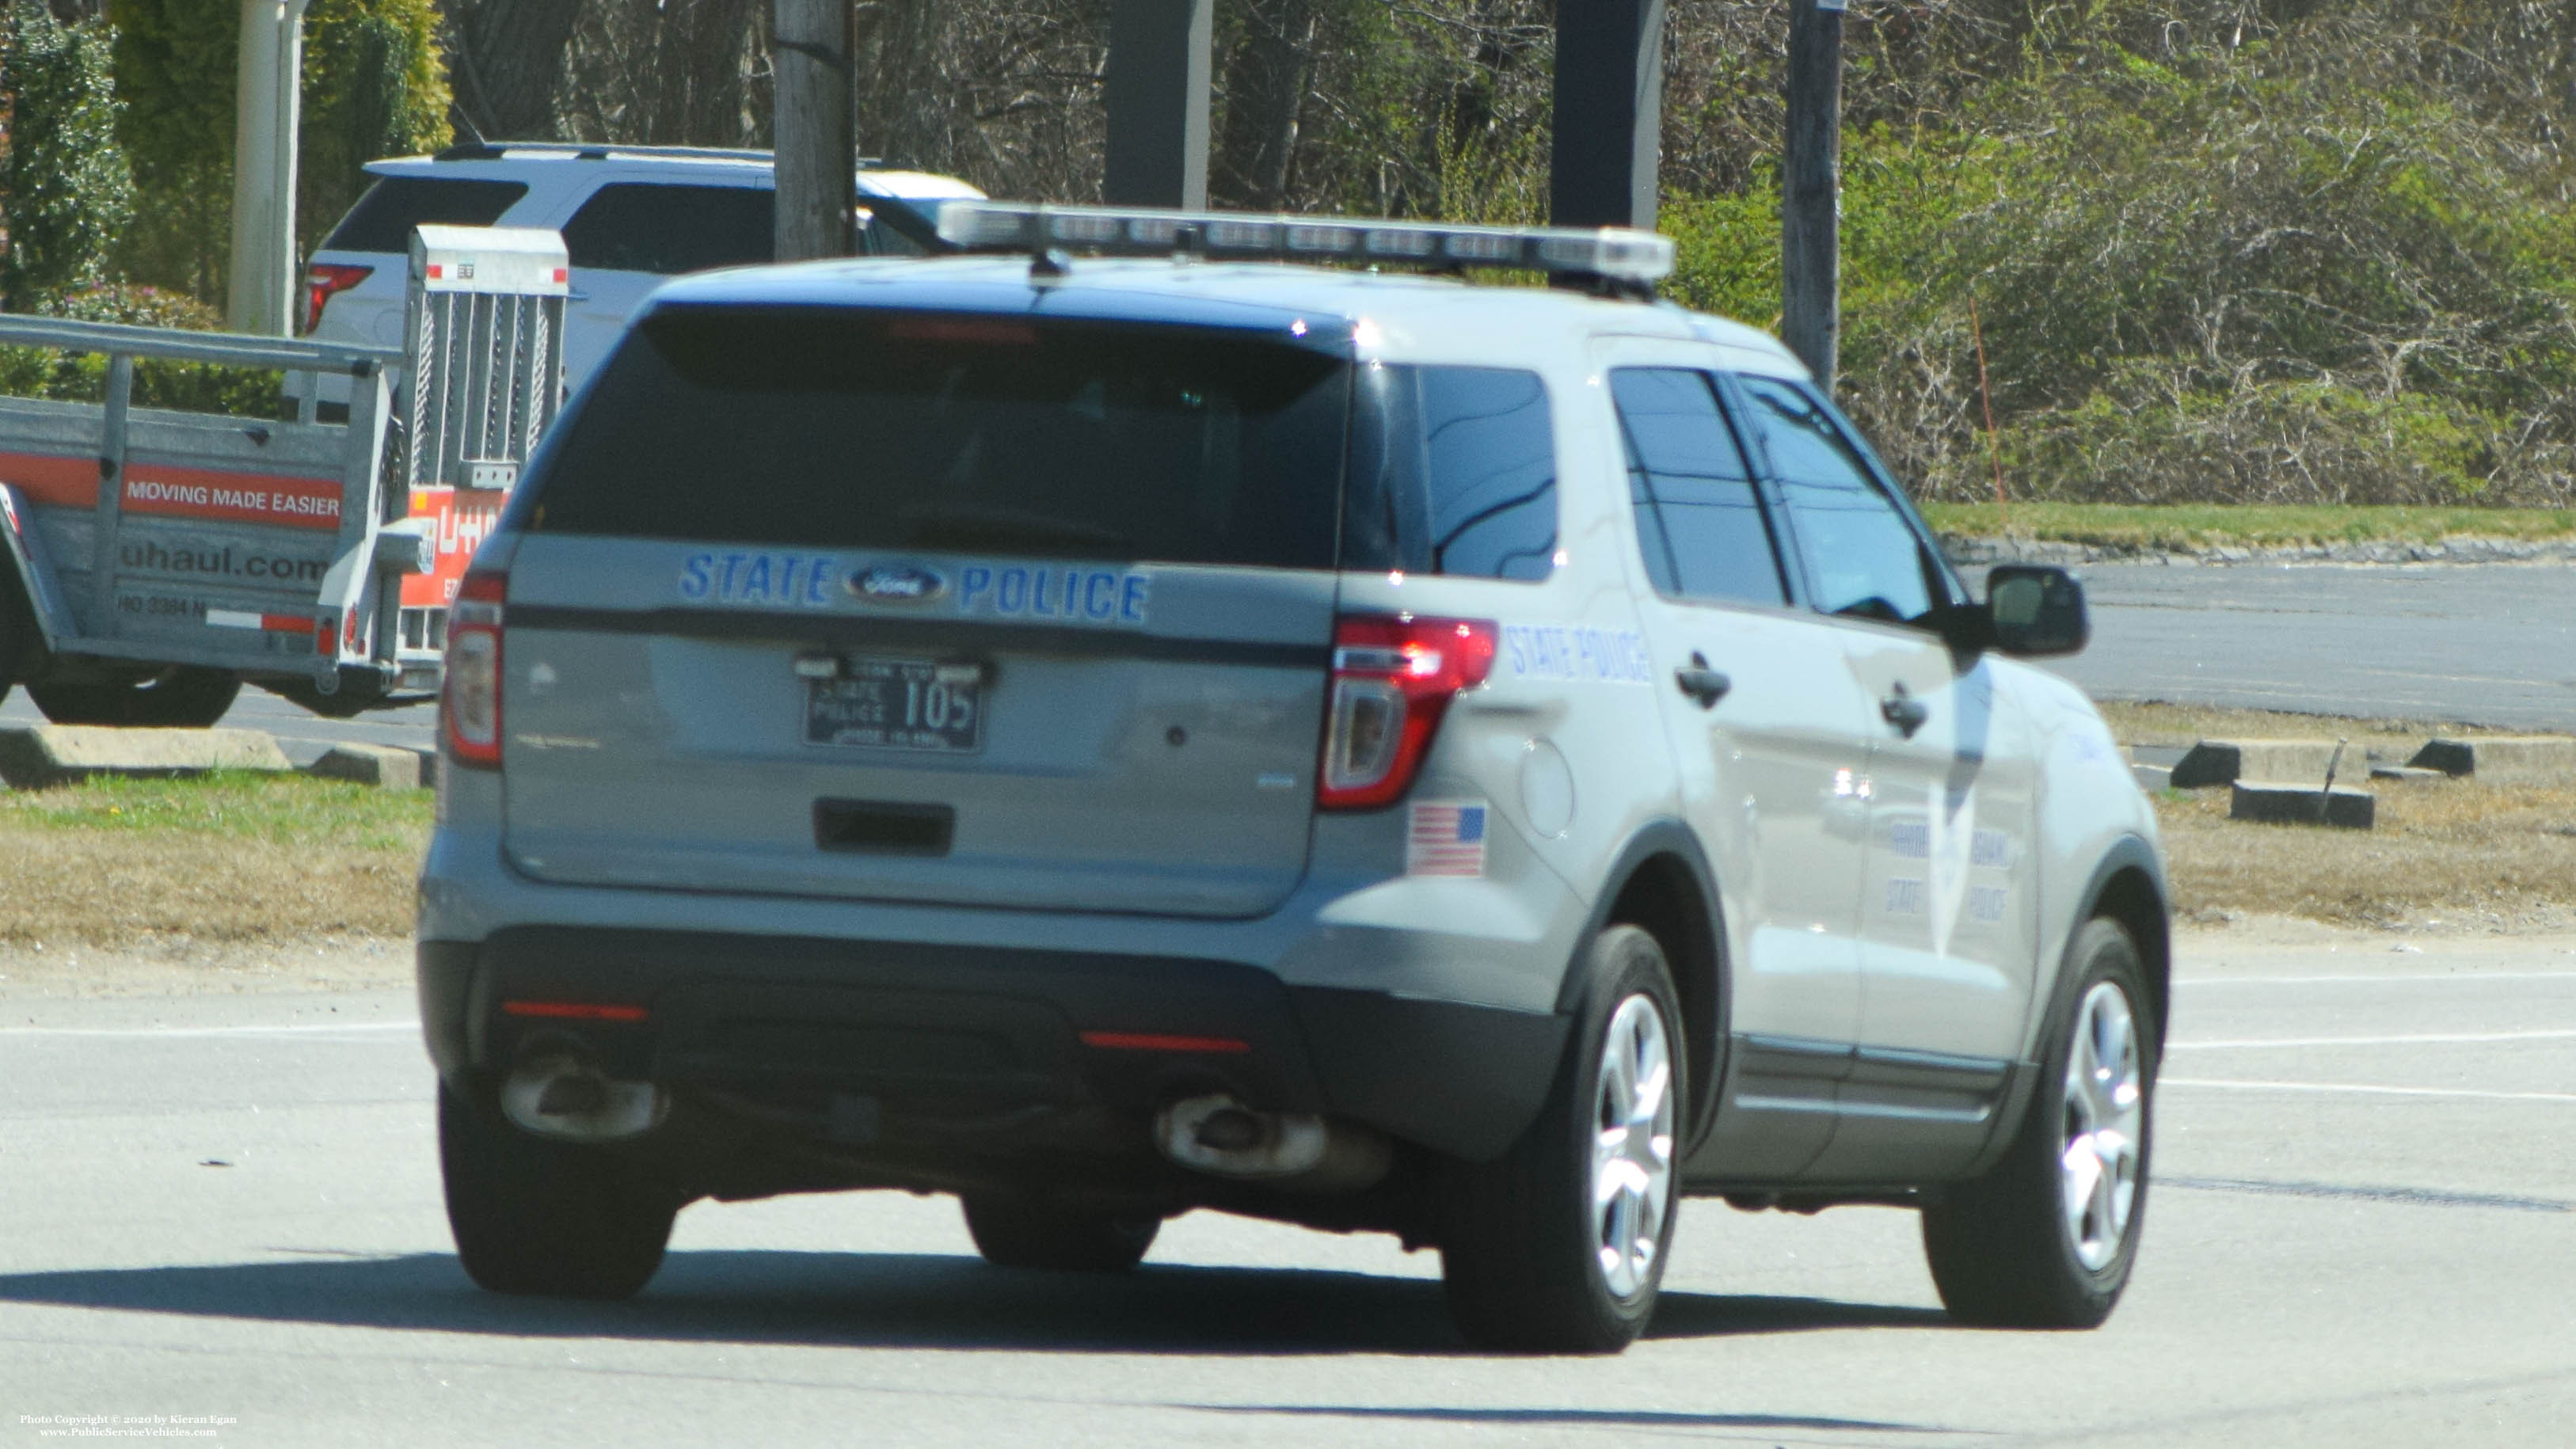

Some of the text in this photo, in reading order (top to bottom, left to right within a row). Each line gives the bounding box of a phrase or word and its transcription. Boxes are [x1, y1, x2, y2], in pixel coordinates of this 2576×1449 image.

[127, 481, 340, 516] MOVING MADE EASIER
[121, 541, 330, 580] uhaul.com
[679, 553, 836, 605] STATE
[960, 565, 1152, 622] POLICE
[1505, 626, 1651, 682] STATE POLICE
[906, 683, 972, 730] 105
